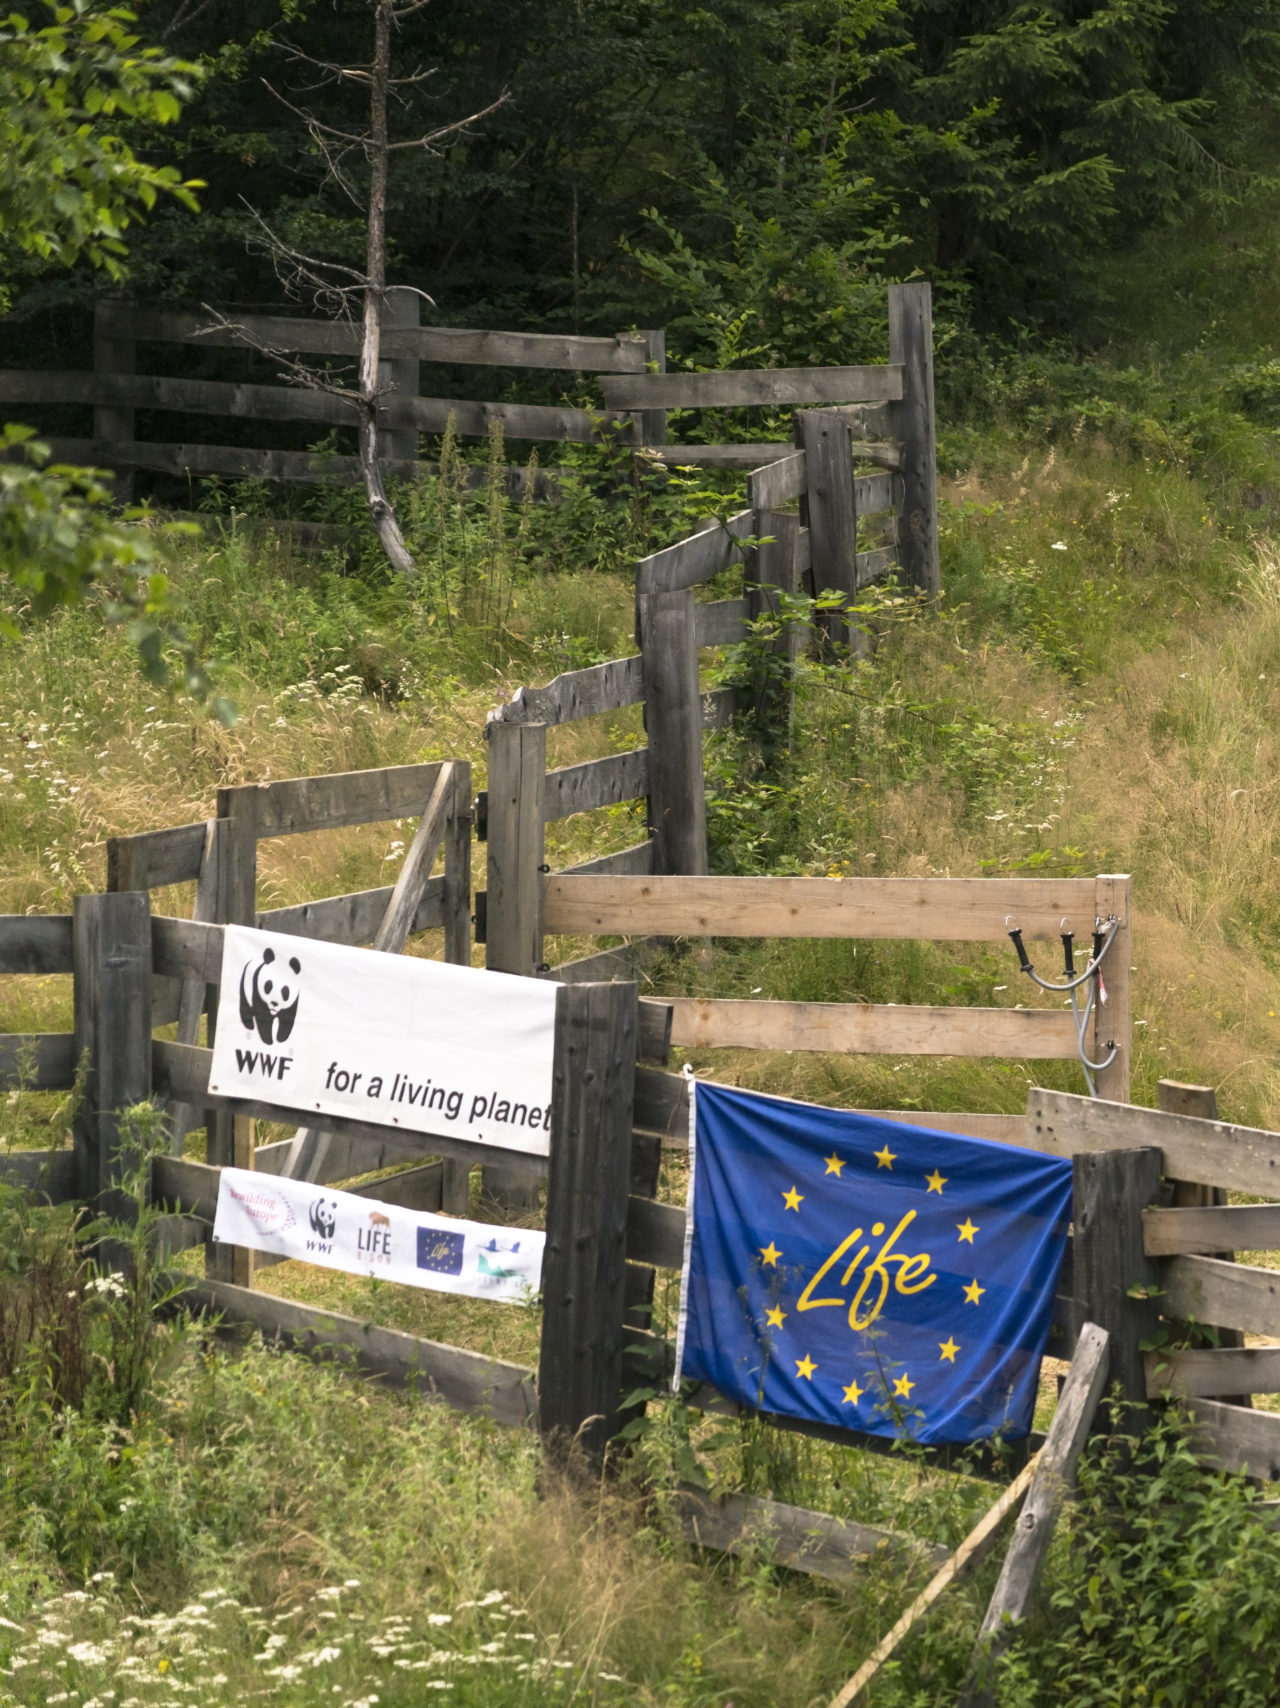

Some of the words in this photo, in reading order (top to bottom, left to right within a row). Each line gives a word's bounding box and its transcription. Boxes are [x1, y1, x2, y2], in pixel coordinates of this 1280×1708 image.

[235, 1049, 293, 1081] WWF
[325, 1061, 362, 1094] for
[367, 1076, 383, 1099] a
[390, 1073, 464, 1121] living
[469, 1092, 551, 1131] planet
[306, 1239, 335, 1255] WWF
[357, 1227, 392, 1255] LIFE
[796, 1209, 937, 1331] Life
